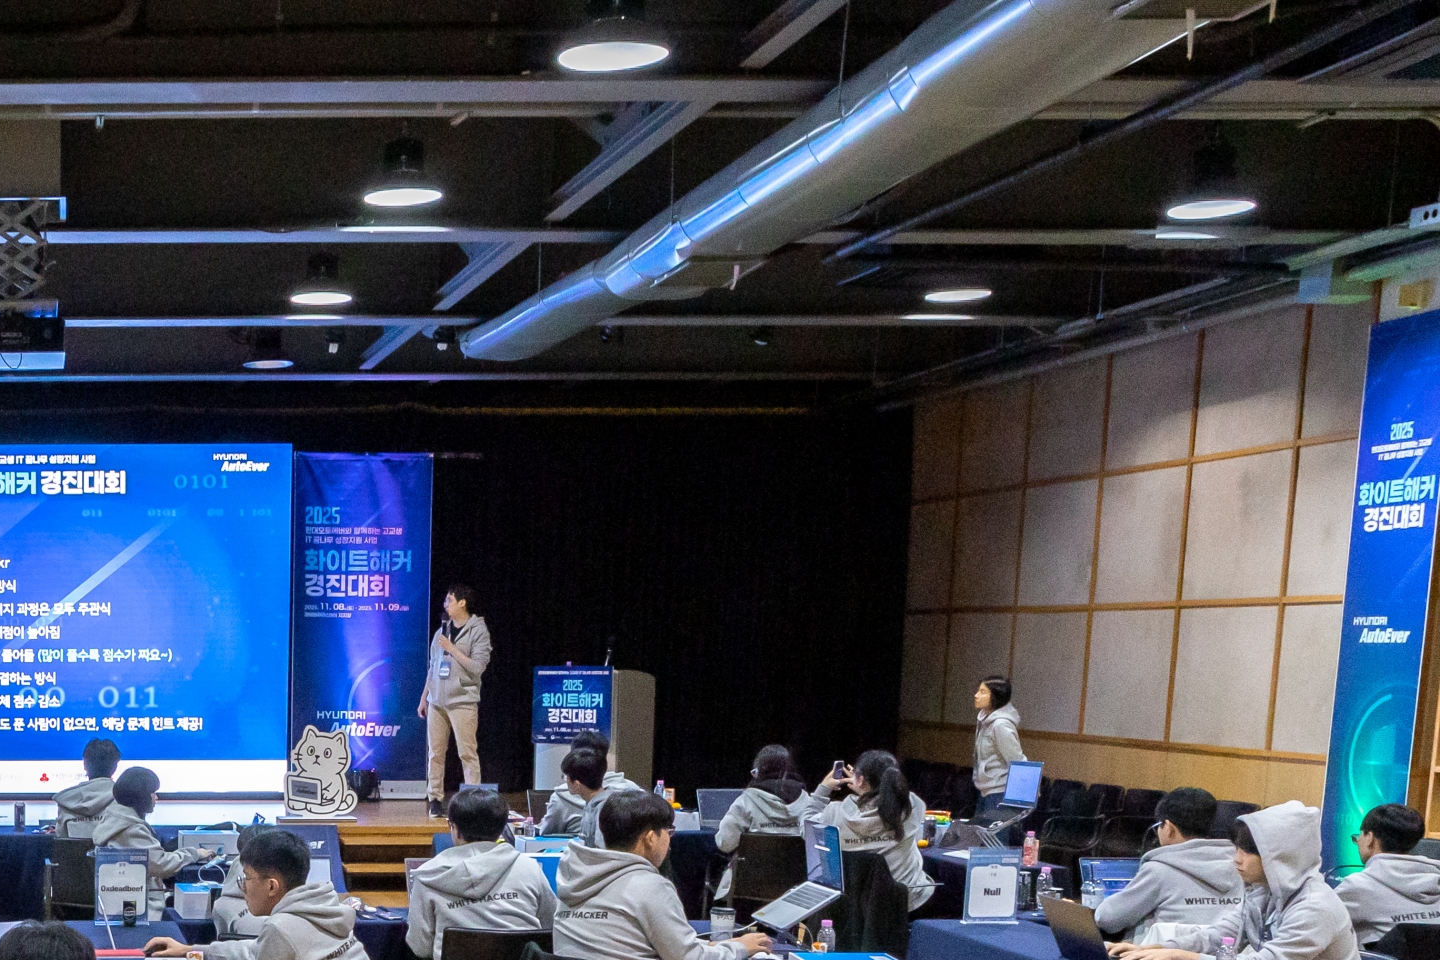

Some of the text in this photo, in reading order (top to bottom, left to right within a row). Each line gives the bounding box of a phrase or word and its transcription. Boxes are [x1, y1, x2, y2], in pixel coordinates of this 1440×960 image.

[1390, 421, 1414, 441] 2025
[16, 456, 24, 464] IT
[221, 462, 270, 472] AutoEver
[40, 470, 126, 494] 경진대회
[1358, 475, 1436, 506] 화이트해커
[305, 506, 340, 524] 2025
[1364, 503, 1425, 532] 경진대회
[304, 549, 412, 572] 화이트해커
[304, 574, 390, 597] 경진대회
[16, 602, 49, 616] 과정은
[52, 602, 75, 616] 모두
[78, 602, 111, 616] 주관식
[1353, 616, 1388, 626] HYUNDAI
[1360, 628, 1410, 644] AutoEver
[38, 649, 63, 662] (많이
[66, 649, 100, 662] 풀수록
[102, 648, 136, 662] 점수가
[34, 672, 56, 685] 방식
[563, 680, 583, 691] 2025
[13, 695, 36, 708] 점수
[38, 695, 60, 708] 감소
[542, 693, 603, 708] 화이트해커
[316, 710, 366, 719] HYUNDAI
[548, 708, 596, 724] 경진대회
[13, 718, 25, 731] 푼
[27, 717, 60, 731] 사람이
[63, 717, 99, 731] 없으면,
[102, 717, 125, 731] 해당
[127, 717, 150, 731] 문제
[152, 717, 175, 731] 힌트
[177, 717, 203, 731] 제공!
[984, 888, 1001, 896] Null
[1184, 897, 1216, 905] WHITE
[572, 911, 608, 919] HACKER
[1391, 912, 1426, 922] WHITE
